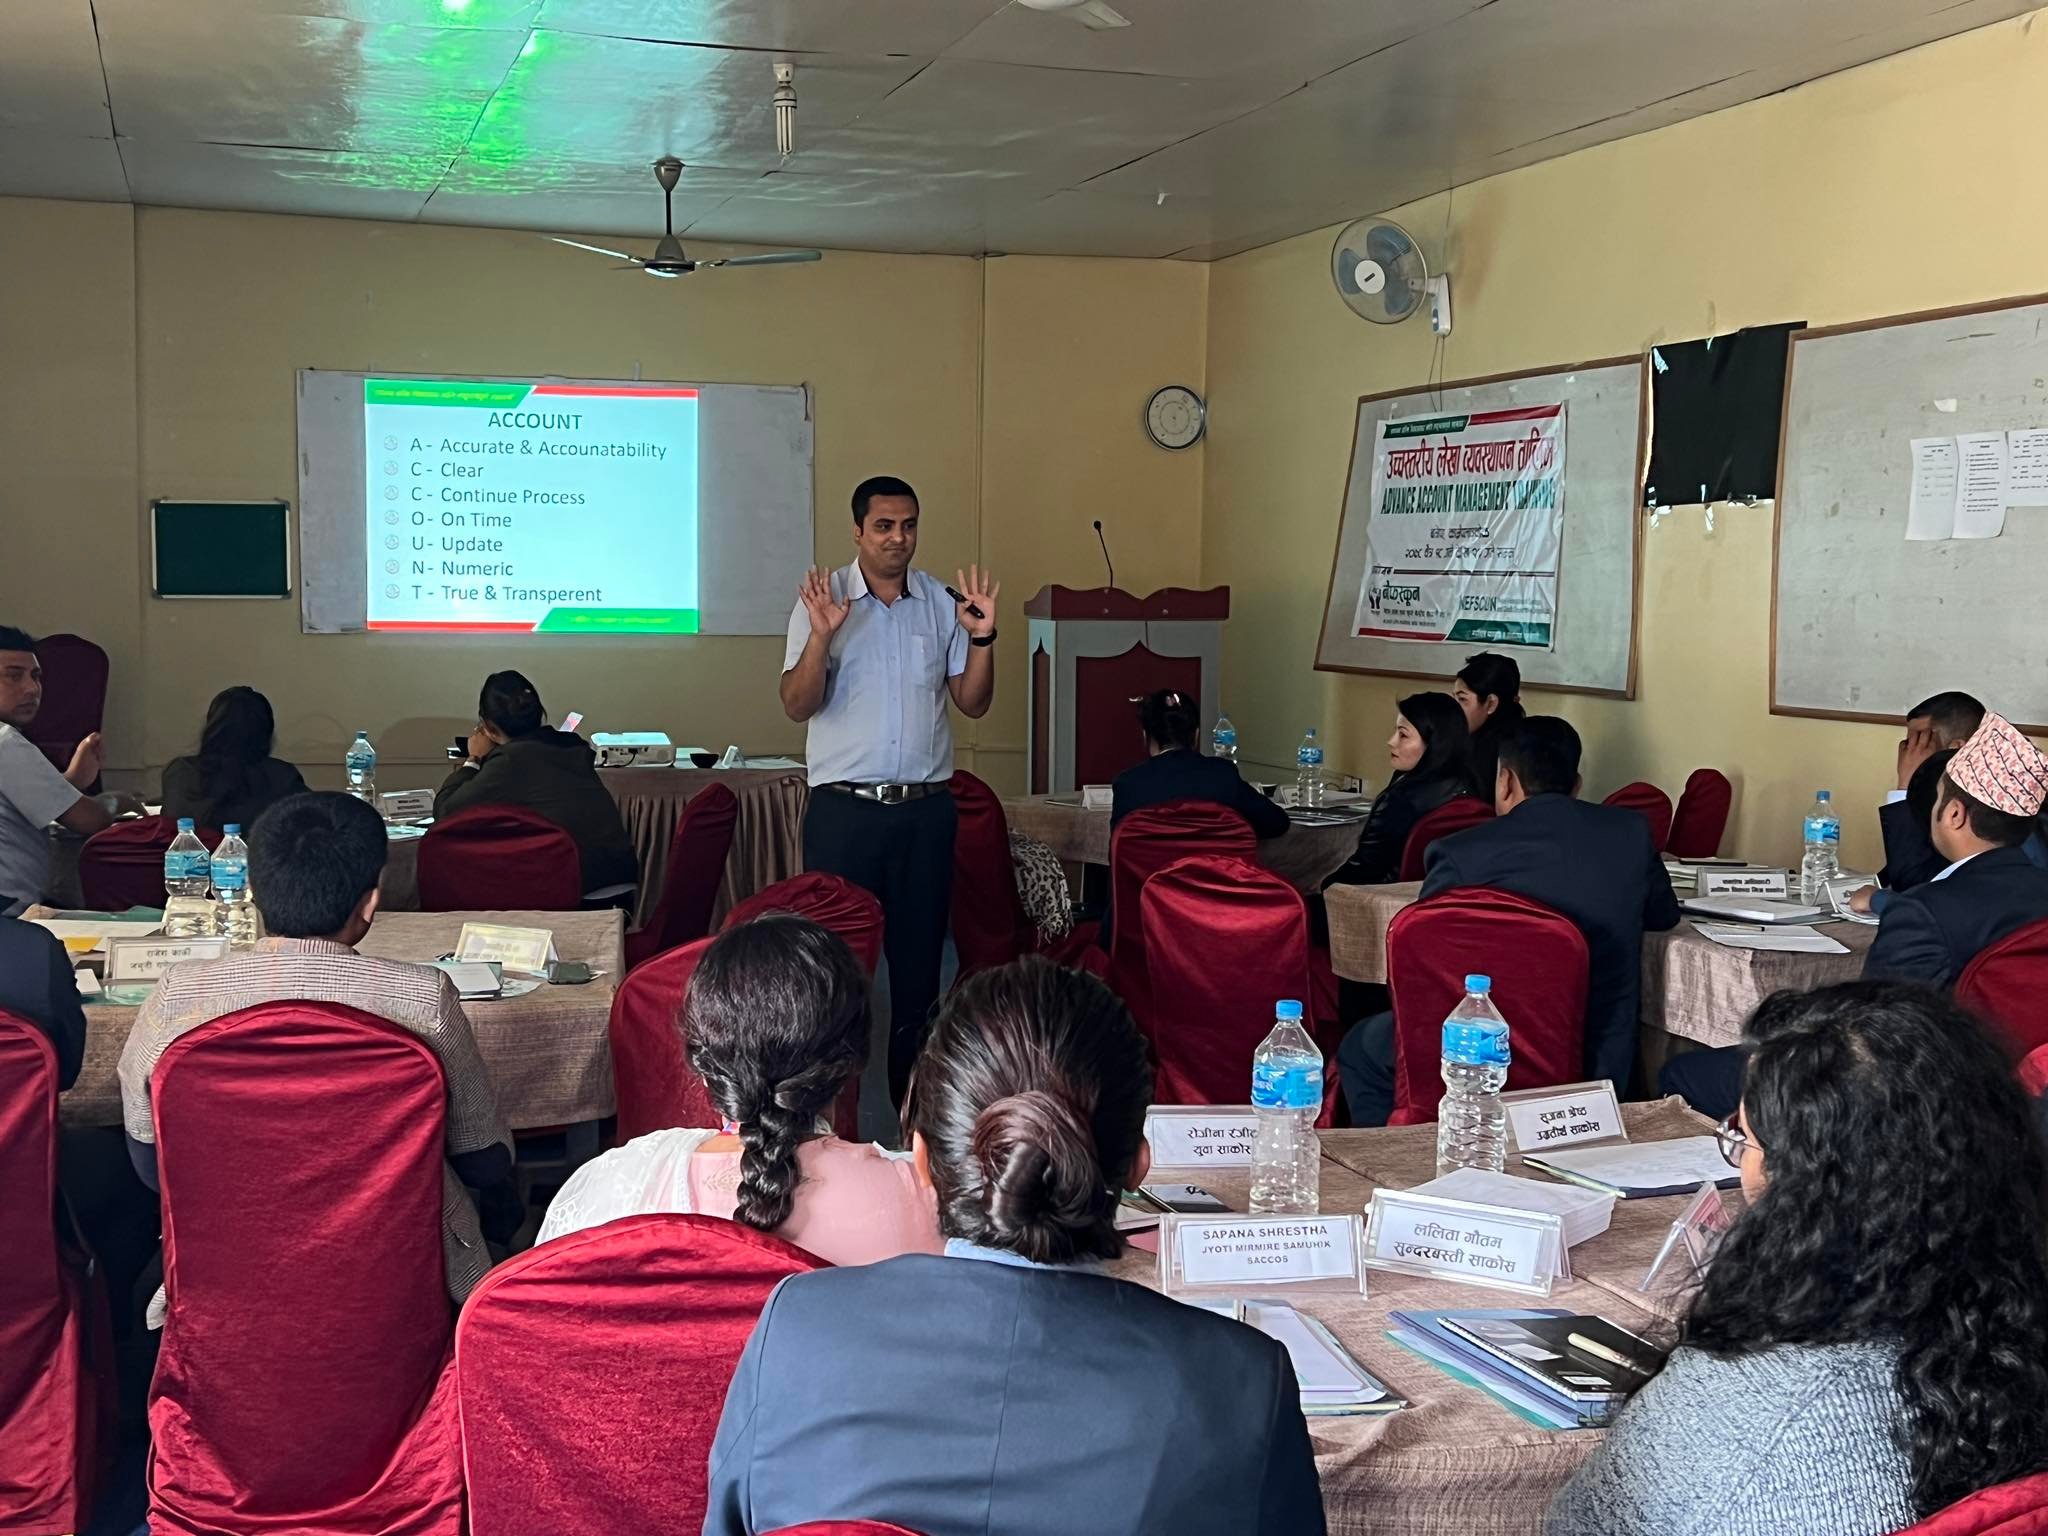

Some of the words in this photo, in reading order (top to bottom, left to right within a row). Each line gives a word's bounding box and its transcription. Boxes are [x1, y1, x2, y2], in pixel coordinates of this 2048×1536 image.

[488, 411, 583, 430] ACCOUNT
[440, 438, 515, 454] Accurate
[520, 439, 534, 455] &
[538, 440, 667, 461] Accounatability
[441, 462, 484, 478] Clear
[441, 487, 518, 503] Continue
[523, 489, 586, 505] Process
[1380, 486, 1416, 515] ADVANCE
[1416, 484, 1454, 514] ACCOUNT
[1454, 480, 1513, 513] MANAGEMENT
[441, 511, 465, 527] On
[470, 512, 513, 528] Time
[442, 536, 503, 555] Update
[442, 561, 514, 577] Numeric
[441, 585, 479, 601] True
[484, 585, 497, 601] &
[502, 586, 602, 604] Transperent
[1458, 594, 1498, 613] NEFSCUN
[1202, 1228, 1256, 1240] SAPANA
[1258, 1225, 1329, 1238] SHRESTHA
[1413, 1222, 1461, 1242] ललिता
[1463, 1229, 1503, 1249] गौतम
[1201, 1245, 1233, 1255] JYOTI
[1235, 1242, 1280, 1253] MIRMIRE
[1282, 1240, 1332, 1251] SAMUHIK
[1246, 1256, 1290, 1265] SACCOS
[1468, 1252, 1517, 1273] साकोस
